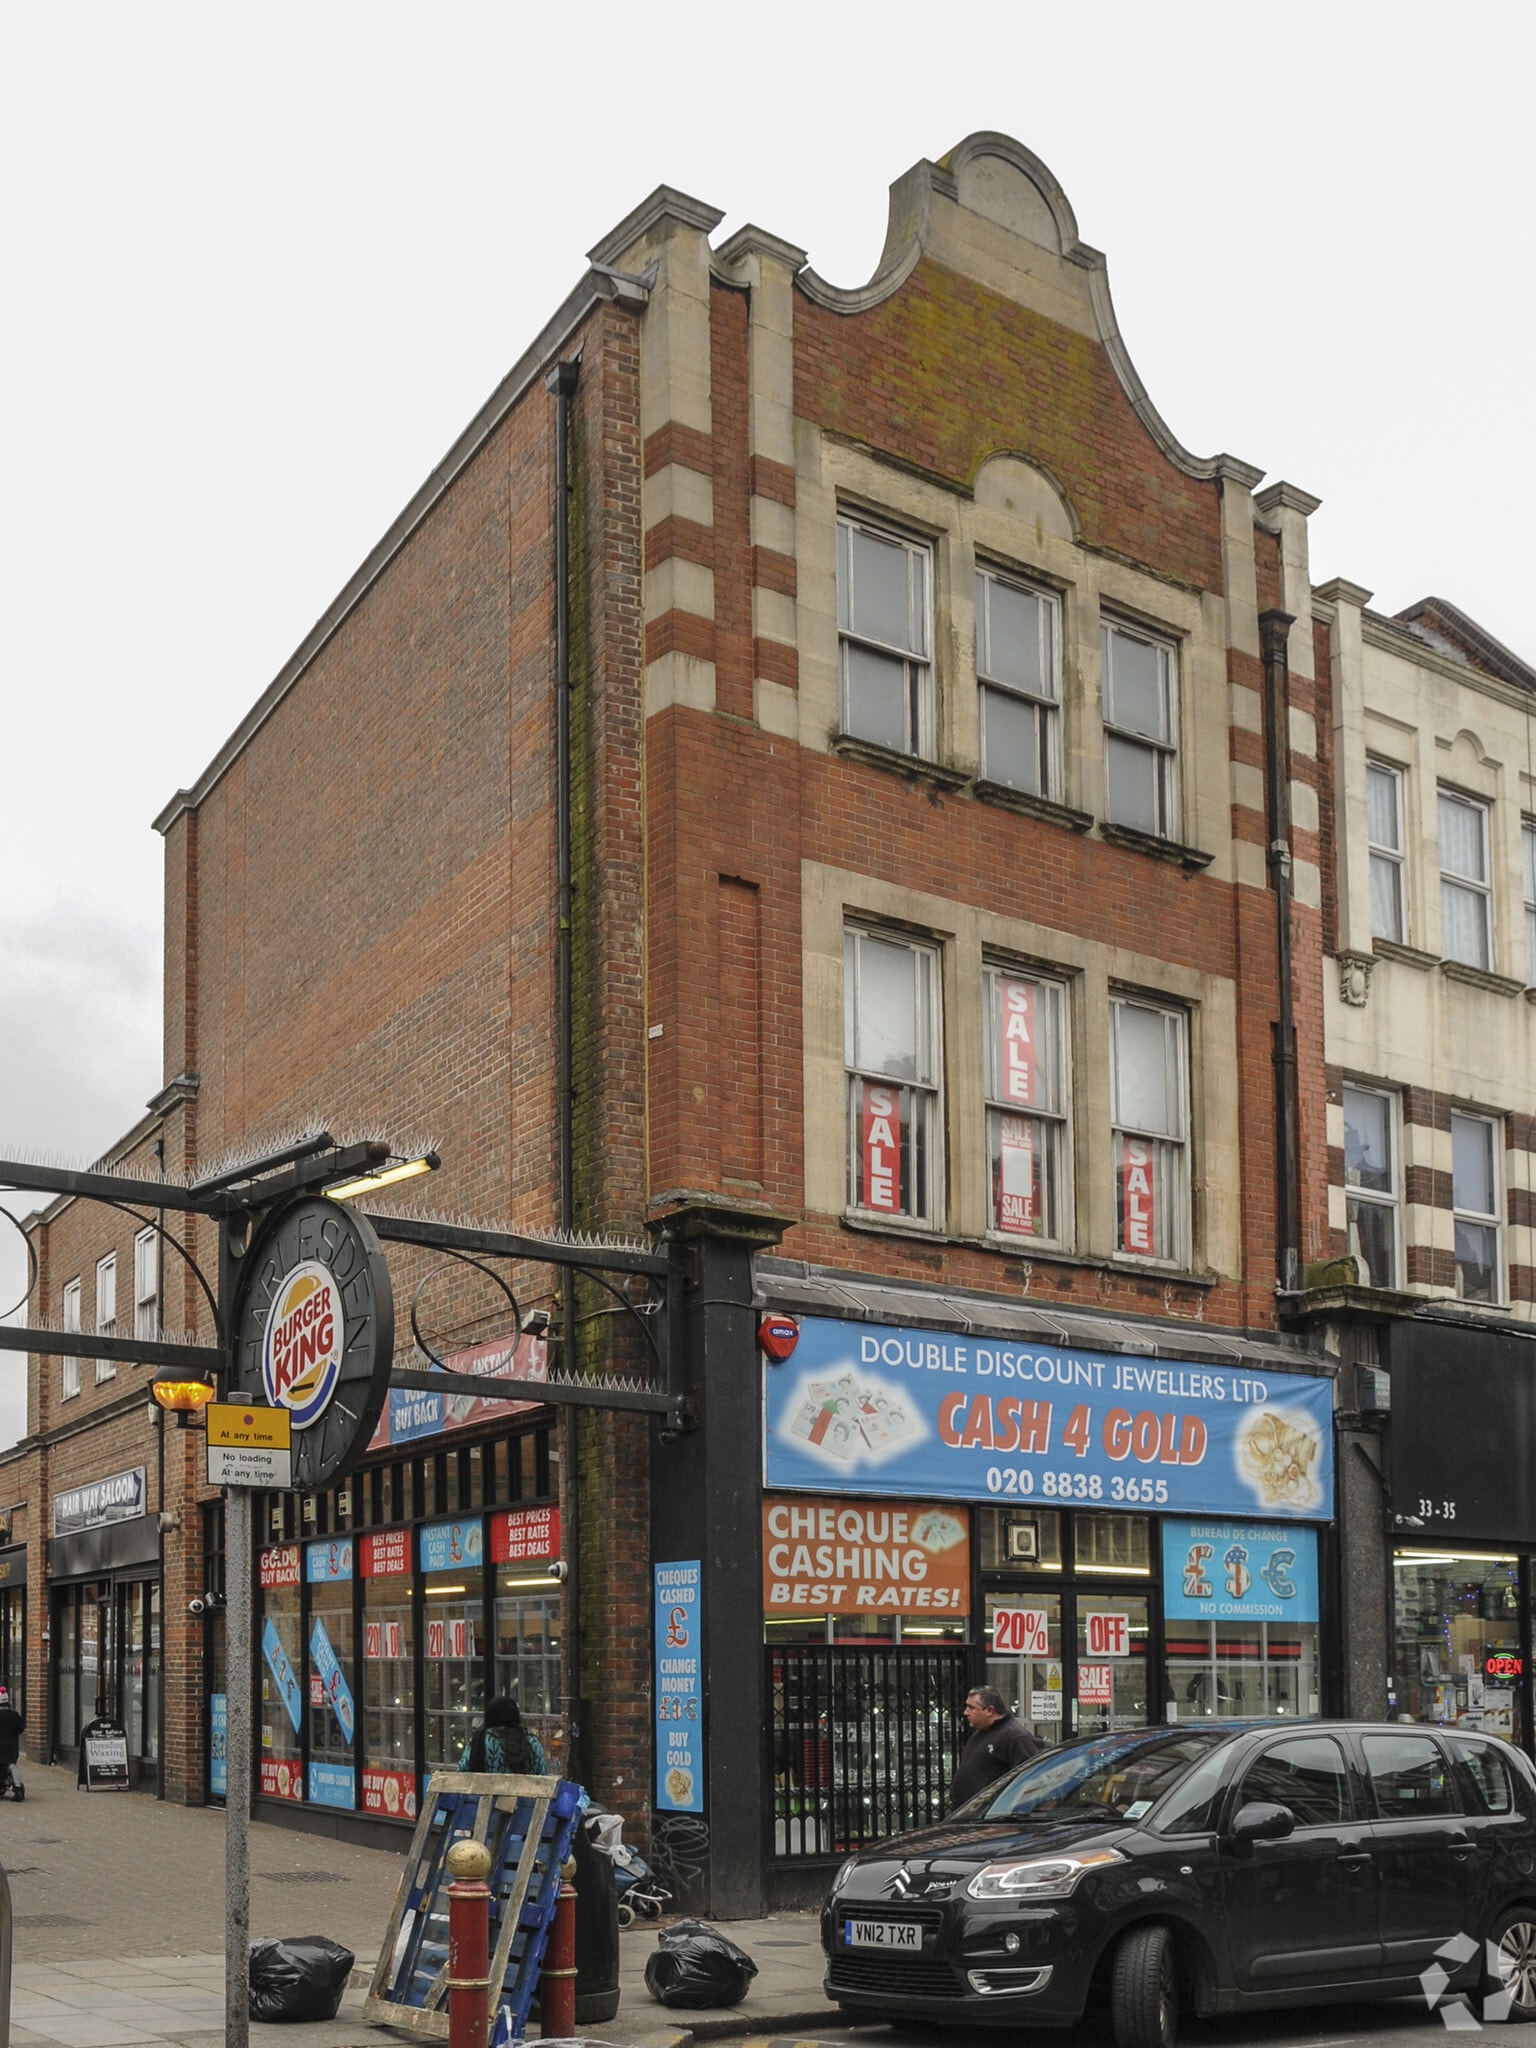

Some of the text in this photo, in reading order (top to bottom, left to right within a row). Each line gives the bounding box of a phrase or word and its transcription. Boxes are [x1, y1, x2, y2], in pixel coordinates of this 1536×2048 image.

[1006, 985, 1030, 1099] SALE
[1002, 1117, 1032, 1142] SALE
[868, 1086, 896, 1207] SALE
[1128, 1140, 1151, 1249] SALE
[1002, 1195, 1032, 1219] SALE
[273, 1286, 331, 1360] BURGER
[772, 1328, 794, 1337] amax
[274, 1313, 334, 1399] KING
[861, 1335, 1268, 1404] DOUBLE DISCOUNT JEWELLERS LTD
[395, 1405, 412, 1431] BUY
[414, 1398, 438, 1426] BACK
[220, 1430, 273, 1441] At any time
[937, 1391, 1208, 1466] CASH 4 GOLD
[222, 1453, 272, 1464] No loading
[221, 1468, 231, 1476] At
[254, 1470, 274, 1478] time
[986, 1466, 1169, 1503] 020 8838 3655
[62, 1493, 80, 1517] HAIR
[82, 1486, 100, 1512] WAY
[101, 1475, 134, 1507] SALOON
[508, 1508, 551, 1526] BEST PRICES
[767, 1505, 909, 1545] CHEQUE
[372, 1531, 405, 1547] BEST PRICES
[423, 1526, 450, 1541] INSTANT
[509, 1524, 549, 1542] BEST RATES
[1190, 1526, 1288, 1542] BUREAU DE CHANGE
[373, 1545, 403, 1560] BEST RATES
[428, 1541, 445, 1554] CASH
[509, 1540, 550, 1557] BEST DEALS
[261, 1551, 289, 1570] GOLD
[312, 1556, 326, 1568] CASH
[373, 1558, 404, 1573] BEST DEALS
[429, 1555, 445, 1568] PAID
[767, 1543, 928, 1582] CASHING
[261, 1568, 295, 1584] BUY BACK
[656, 1568, 698, 1586] CHEQUES
[659, 1587, 695, 1604] CASHED
[769, 1583, 960, 1608] BEST RATES!
[1200, 1603, 1284, 1615] NO COMMISSION
[995, 1611, 1125, 1652] 20% OFF
[659, 1658, 696, 1675] CHANGE
[1486, 1658, 1523, 1674] OPEN
[661, 1678, 695, 1693] MONEY
[1080, 1667, 1110, 1689] SALE
[89, 1742, 124, 1750] Threading
[669, 1731, 689, 1747] BUY
[89, 1749, 125, 1758] Waxing
[666, 1751, 692, 1766] GOLD
[270, 1764, 278, 1778] BUY
[263, 1778, 275, 1793] GOLD
[363, 1774, 384, 1791] WE BUY
[366, 1792, 381, 1808] GOLD
[856, 1923, 916, 1945] VN12 TXR
